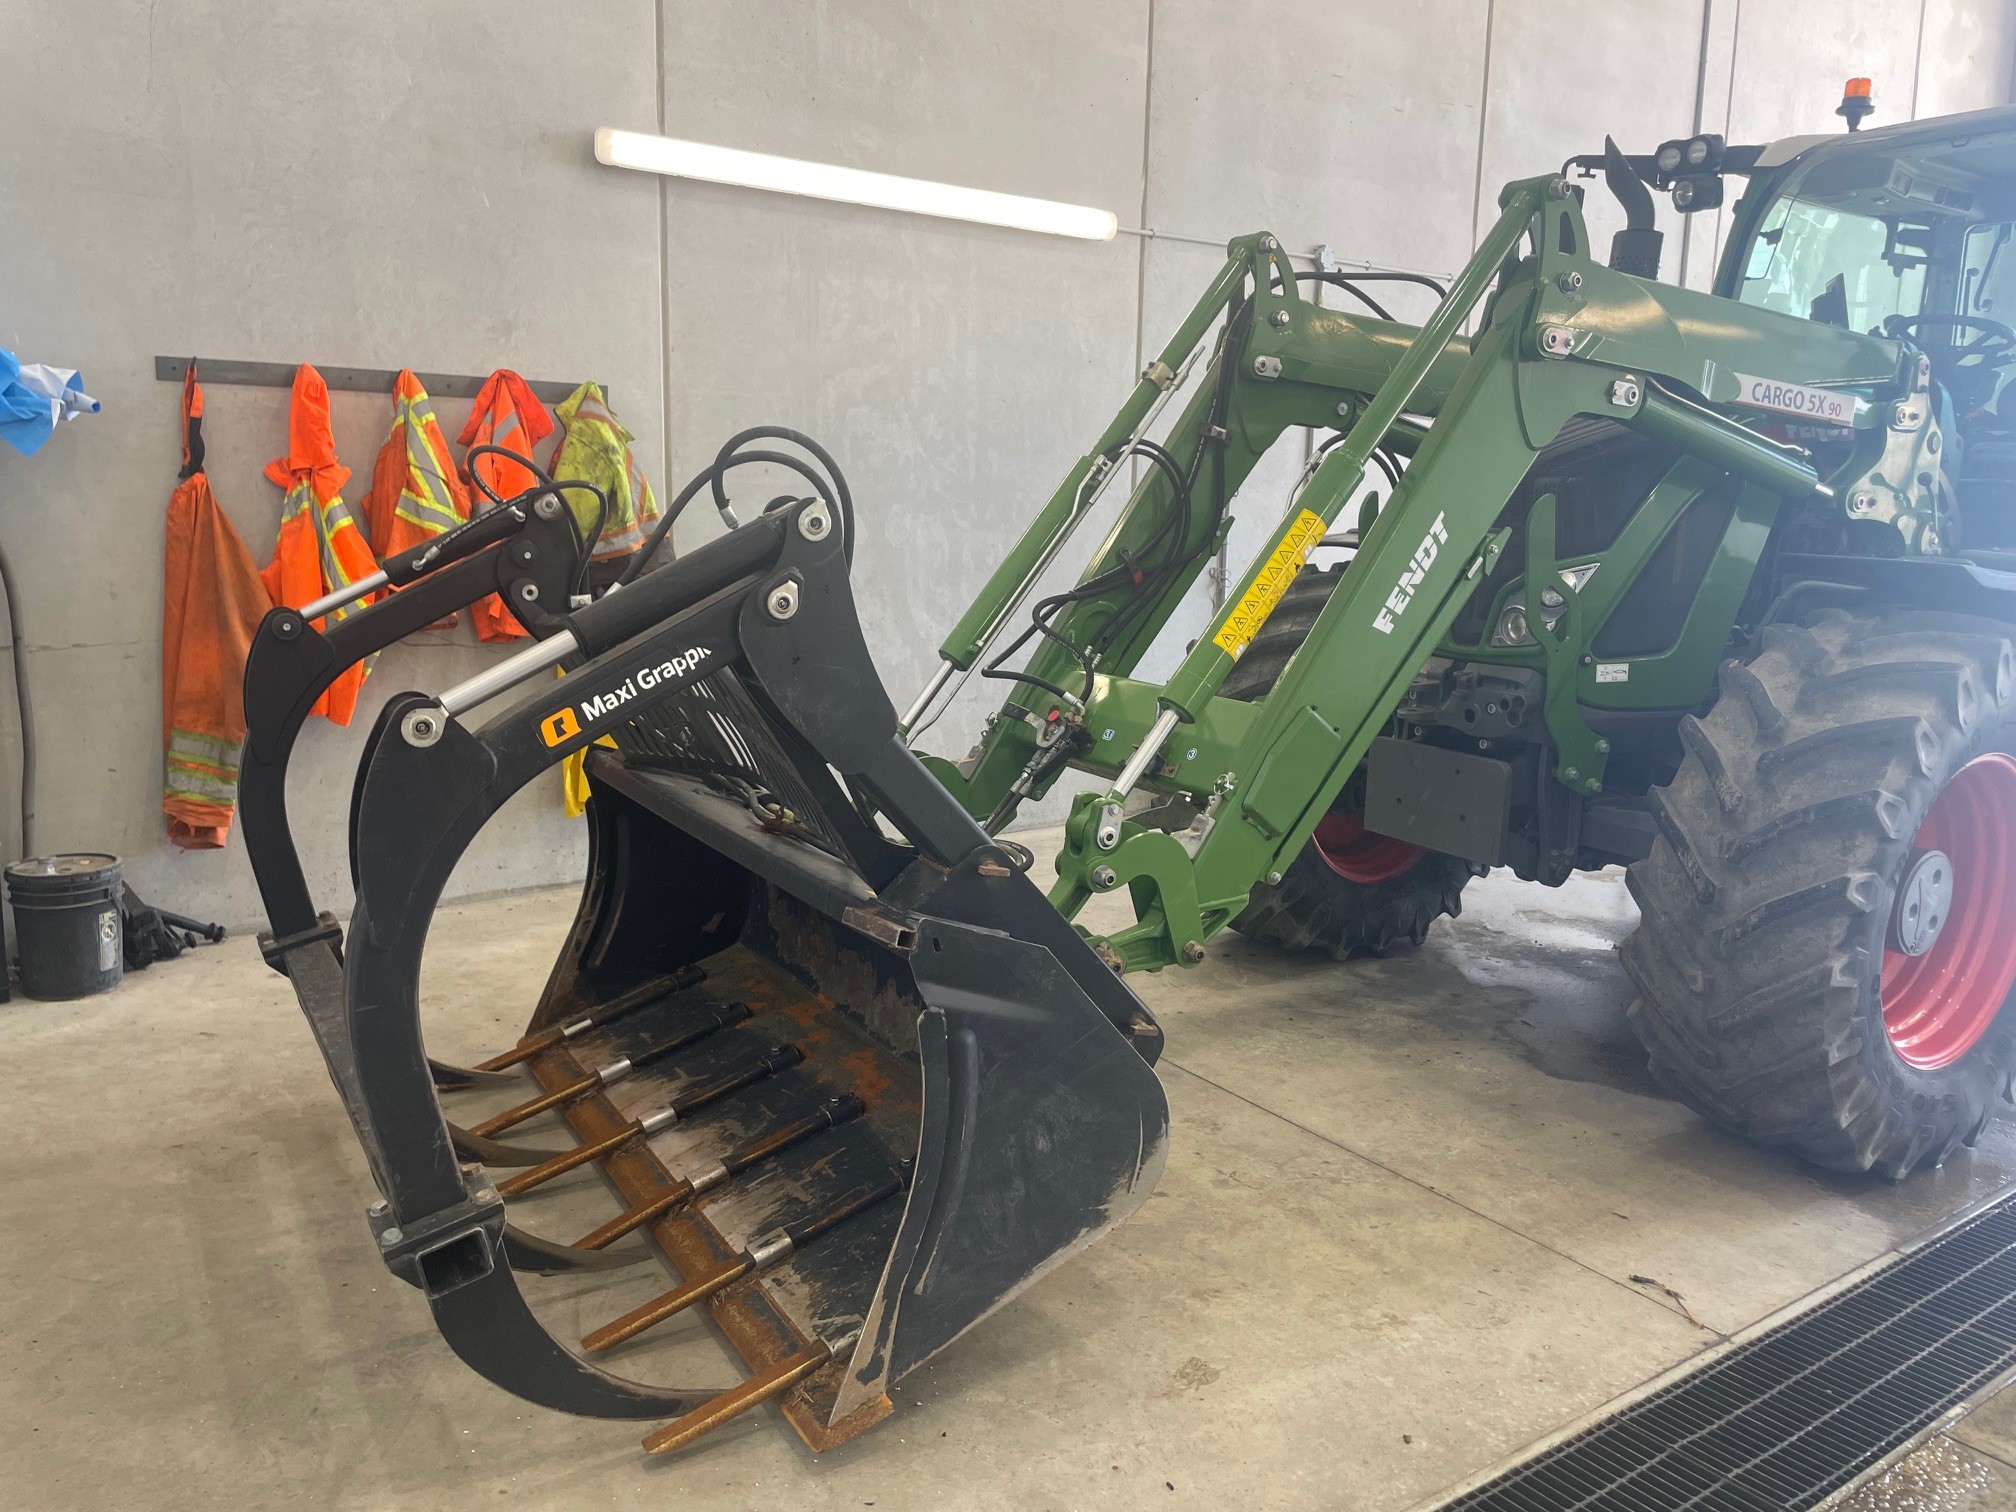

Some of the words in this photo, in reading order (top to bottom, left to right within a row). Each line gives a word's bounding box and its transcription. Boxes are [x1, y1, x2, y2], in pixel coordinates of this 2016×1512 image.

[1752, 382, 1805, 409] CARGO
[1808, 394, 1827, 414] 5X
[1829, 402, 1842, 417] 90
[1372, 510, 1448, 634] FENDT
[580, 678, 638, 721] Maxi
